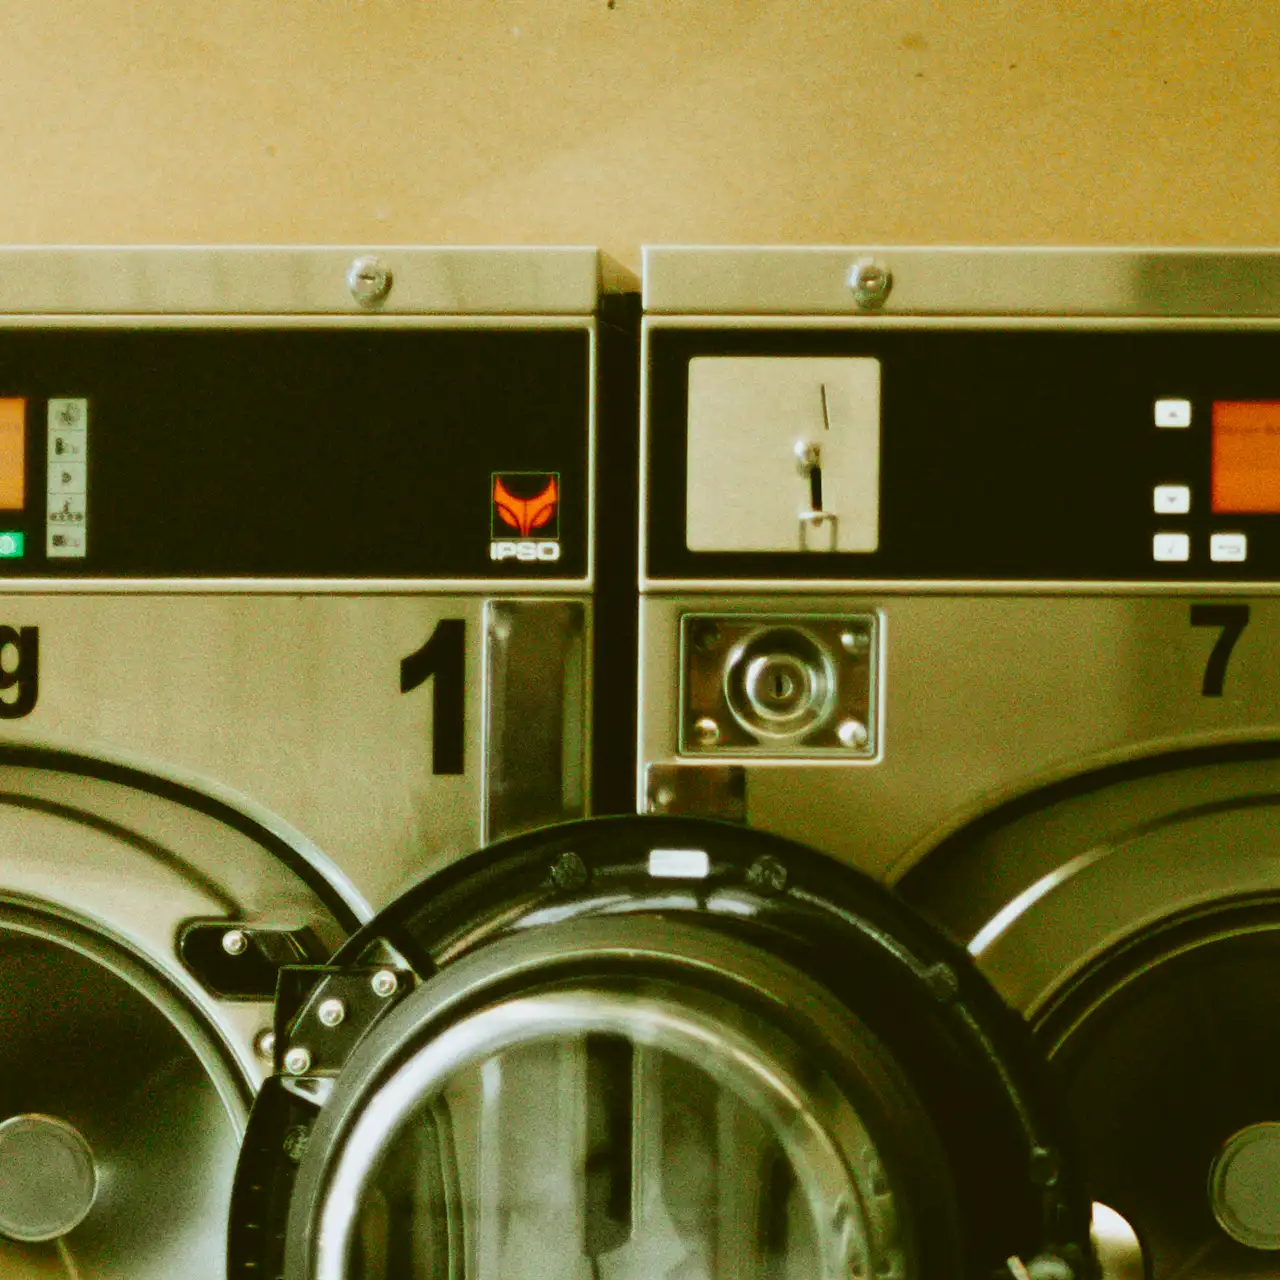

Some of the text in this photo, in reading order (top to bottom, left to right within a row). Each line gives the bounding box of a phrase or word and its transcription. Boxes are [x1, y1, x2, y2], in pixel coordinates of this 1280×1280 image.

[490, 541, 560, 561] IPSO
[400, 619, 466, 775] 1
[1189, 604, 1251, 698] 7
